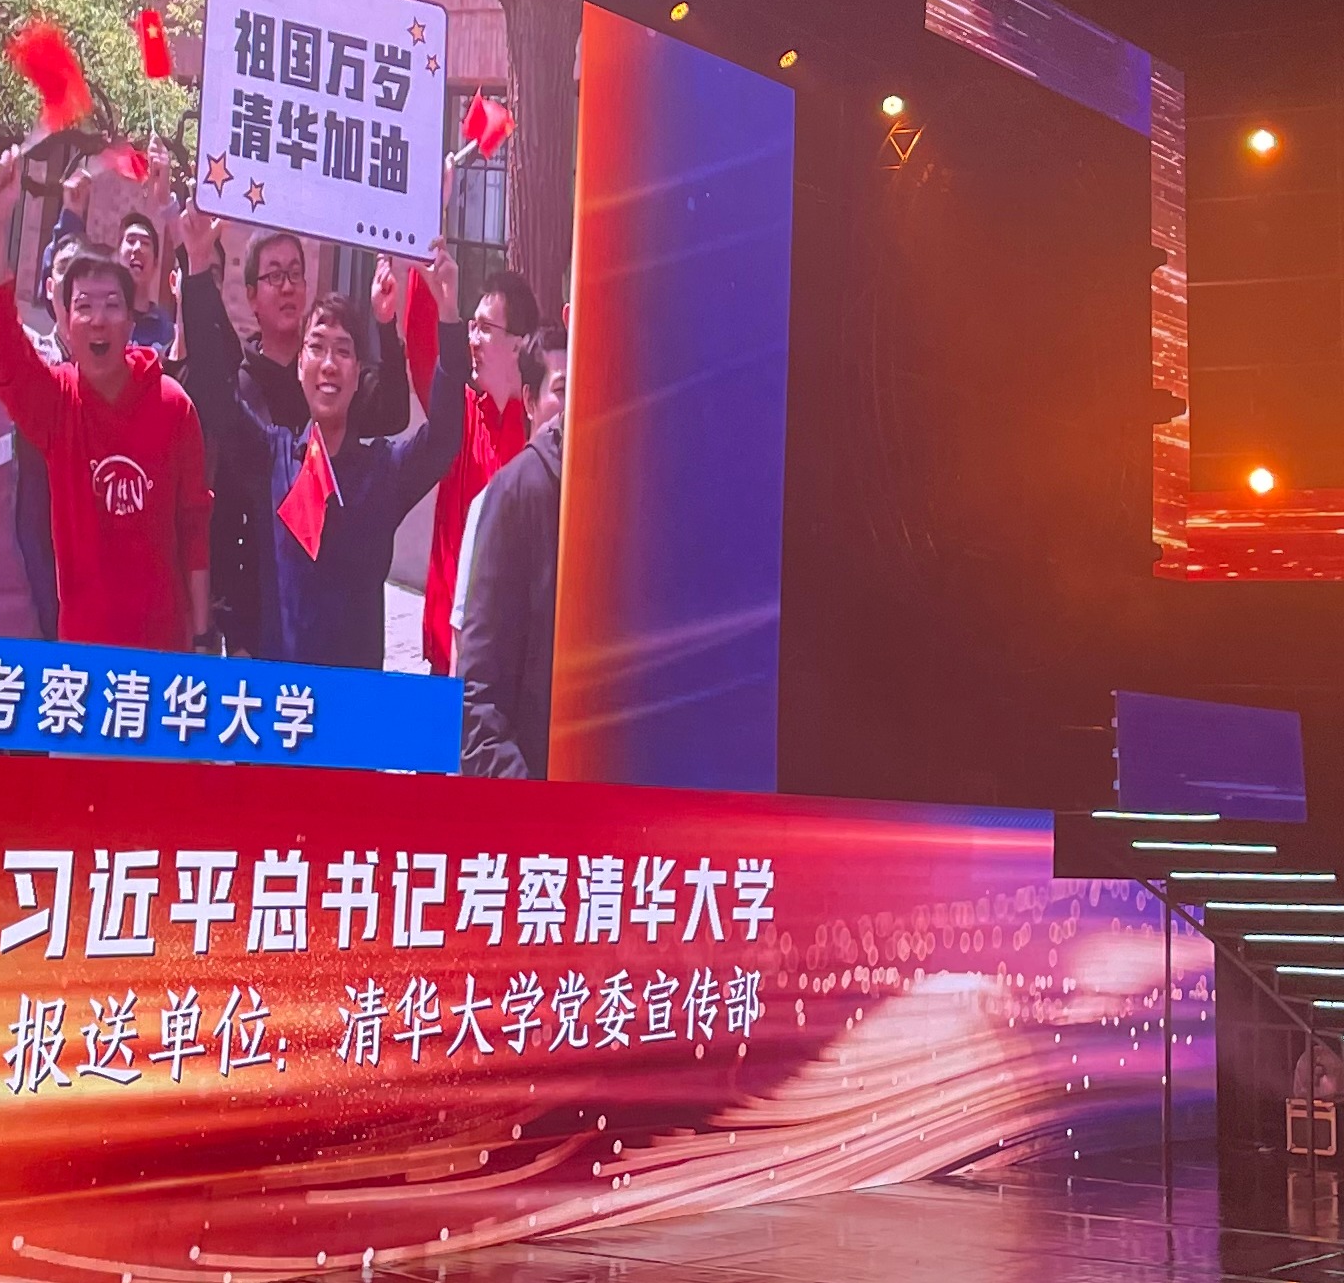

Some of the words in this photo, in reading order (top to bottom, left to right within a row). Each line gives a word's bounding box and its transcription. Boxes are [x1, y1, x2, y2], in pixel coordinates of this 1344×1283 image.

[234, 8, 413, 113] 祖国万岁
[229, 90, 410, 194] 清华加油
[0, 848, 776, 959] 习近平总书记考察清华大学
